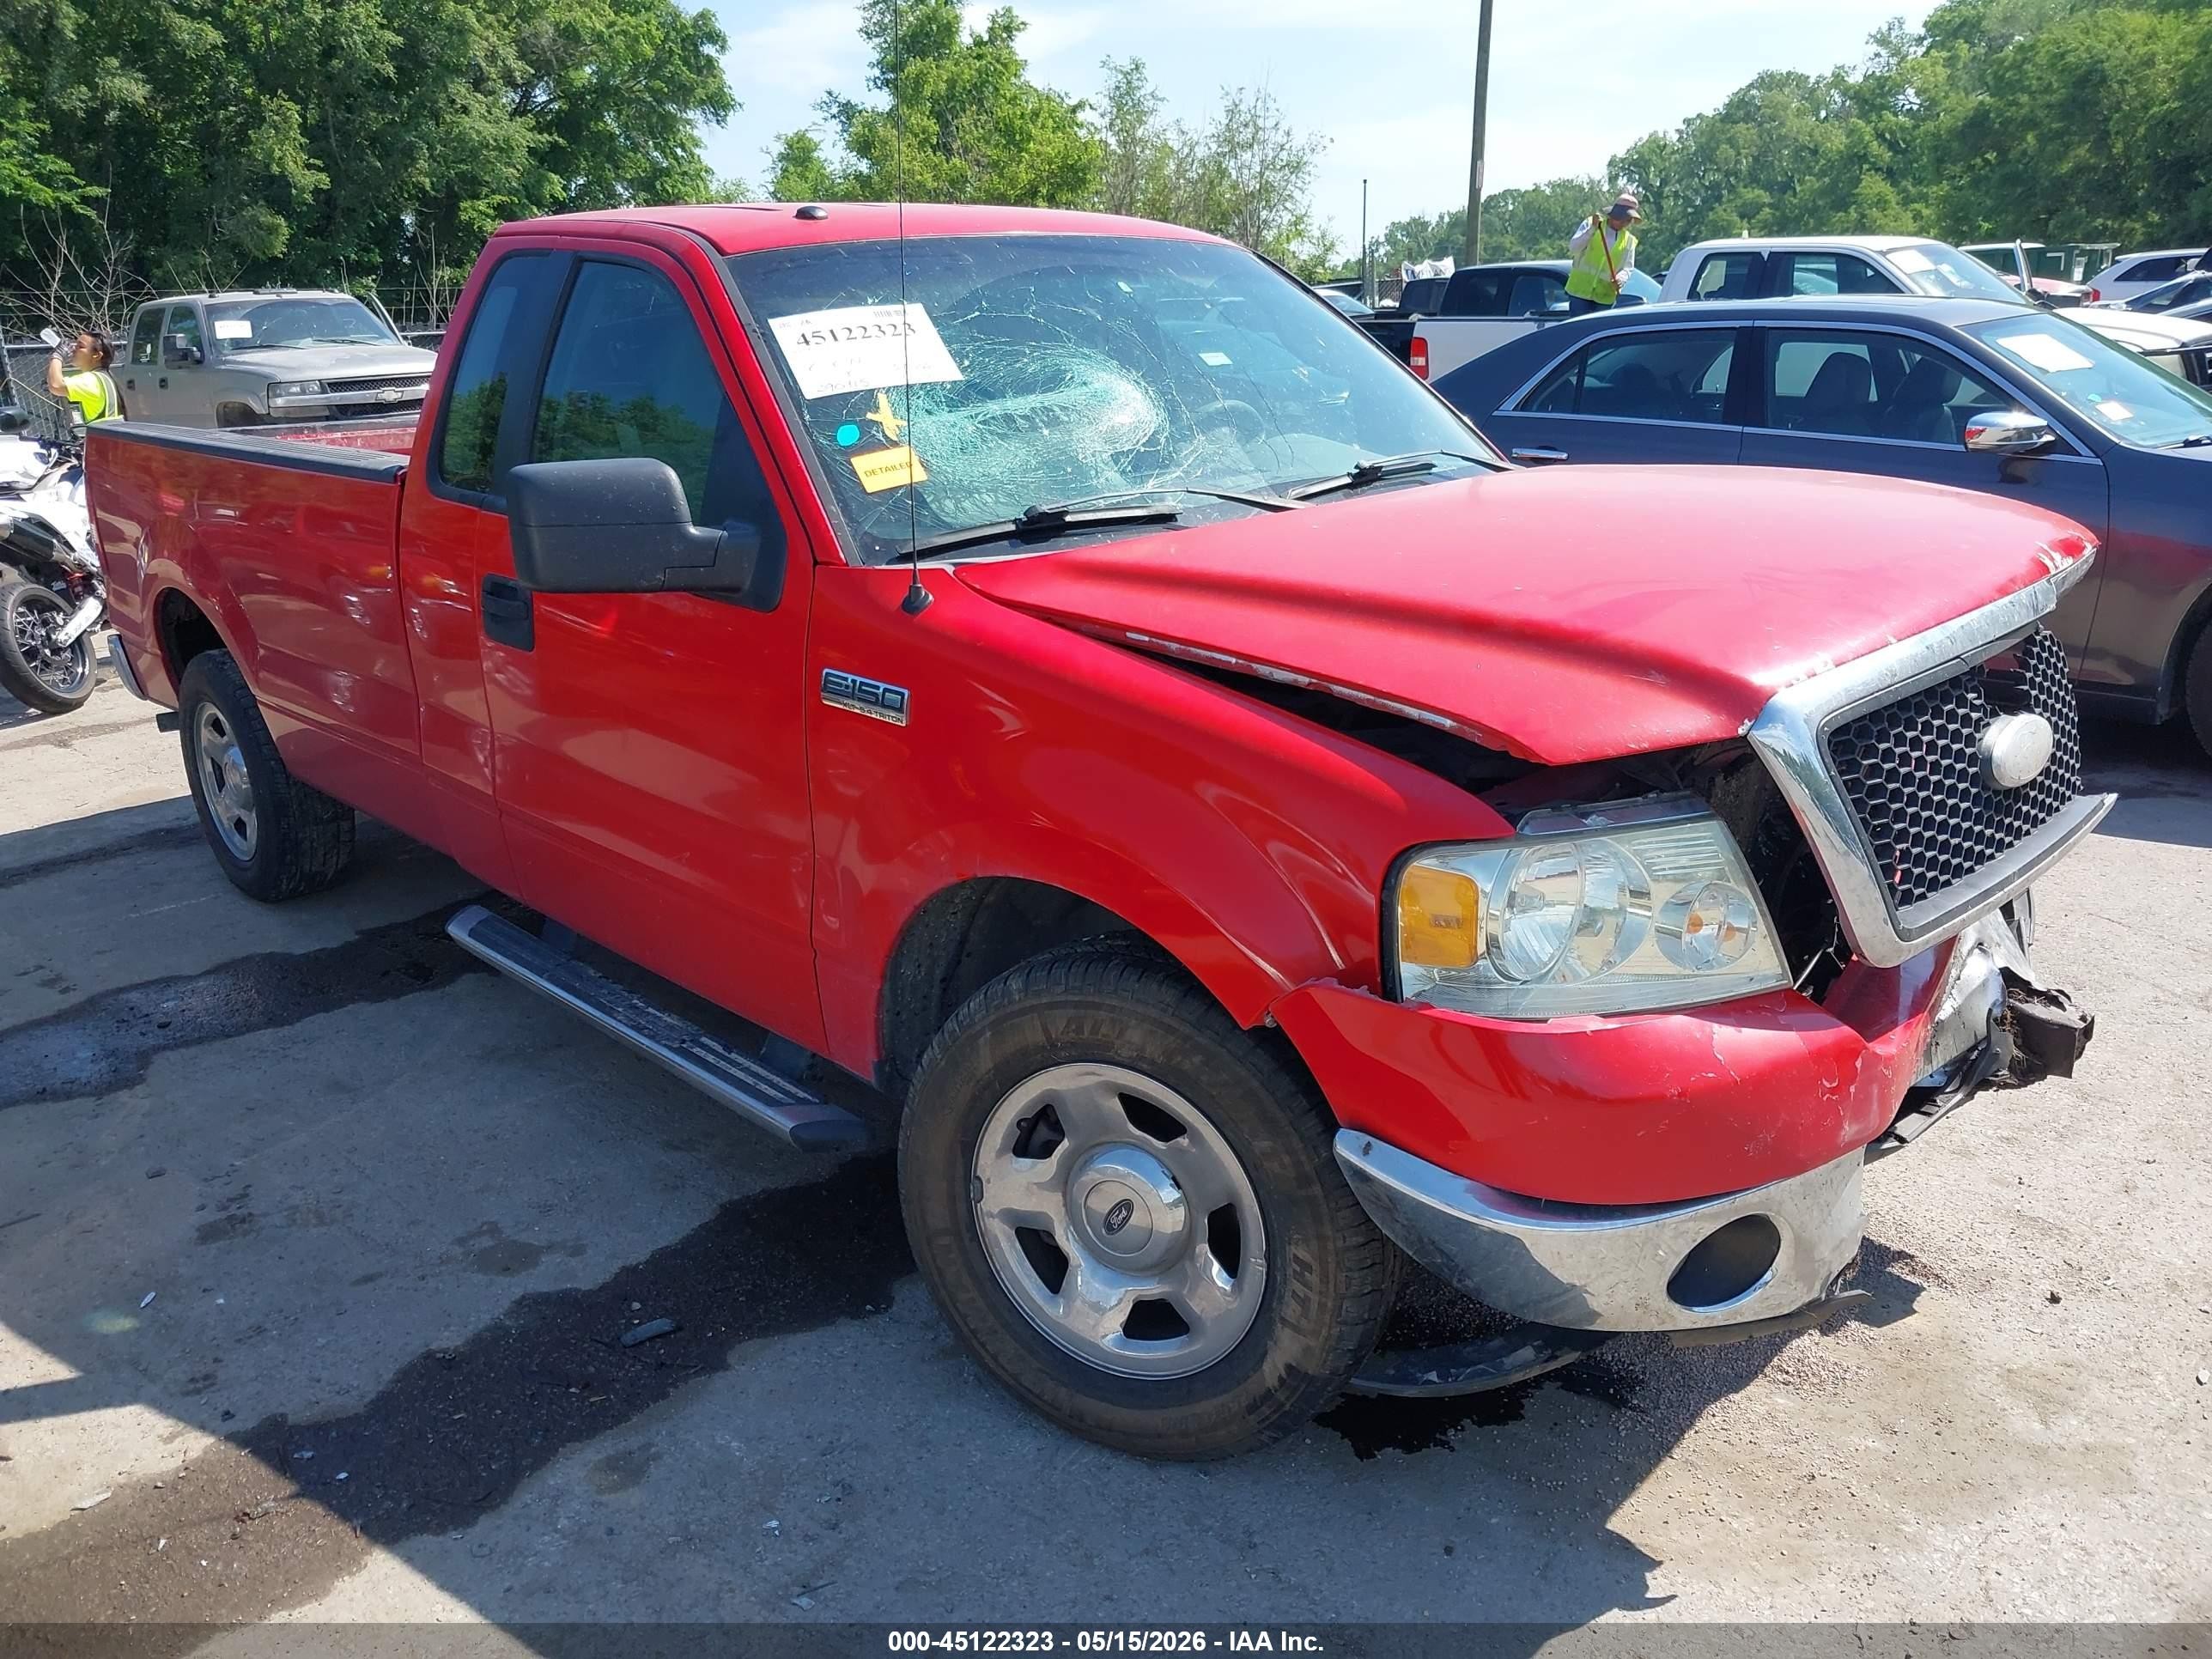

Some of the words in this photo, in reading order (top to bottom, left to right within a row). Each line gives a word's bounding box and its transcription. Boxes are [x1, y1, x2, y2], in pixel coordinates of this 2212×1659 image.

[797, 322, 916, 347] 45122323
[864, 462, 913, 477] DETAILED
[1110, 1206, 1127, 1229] Ford
